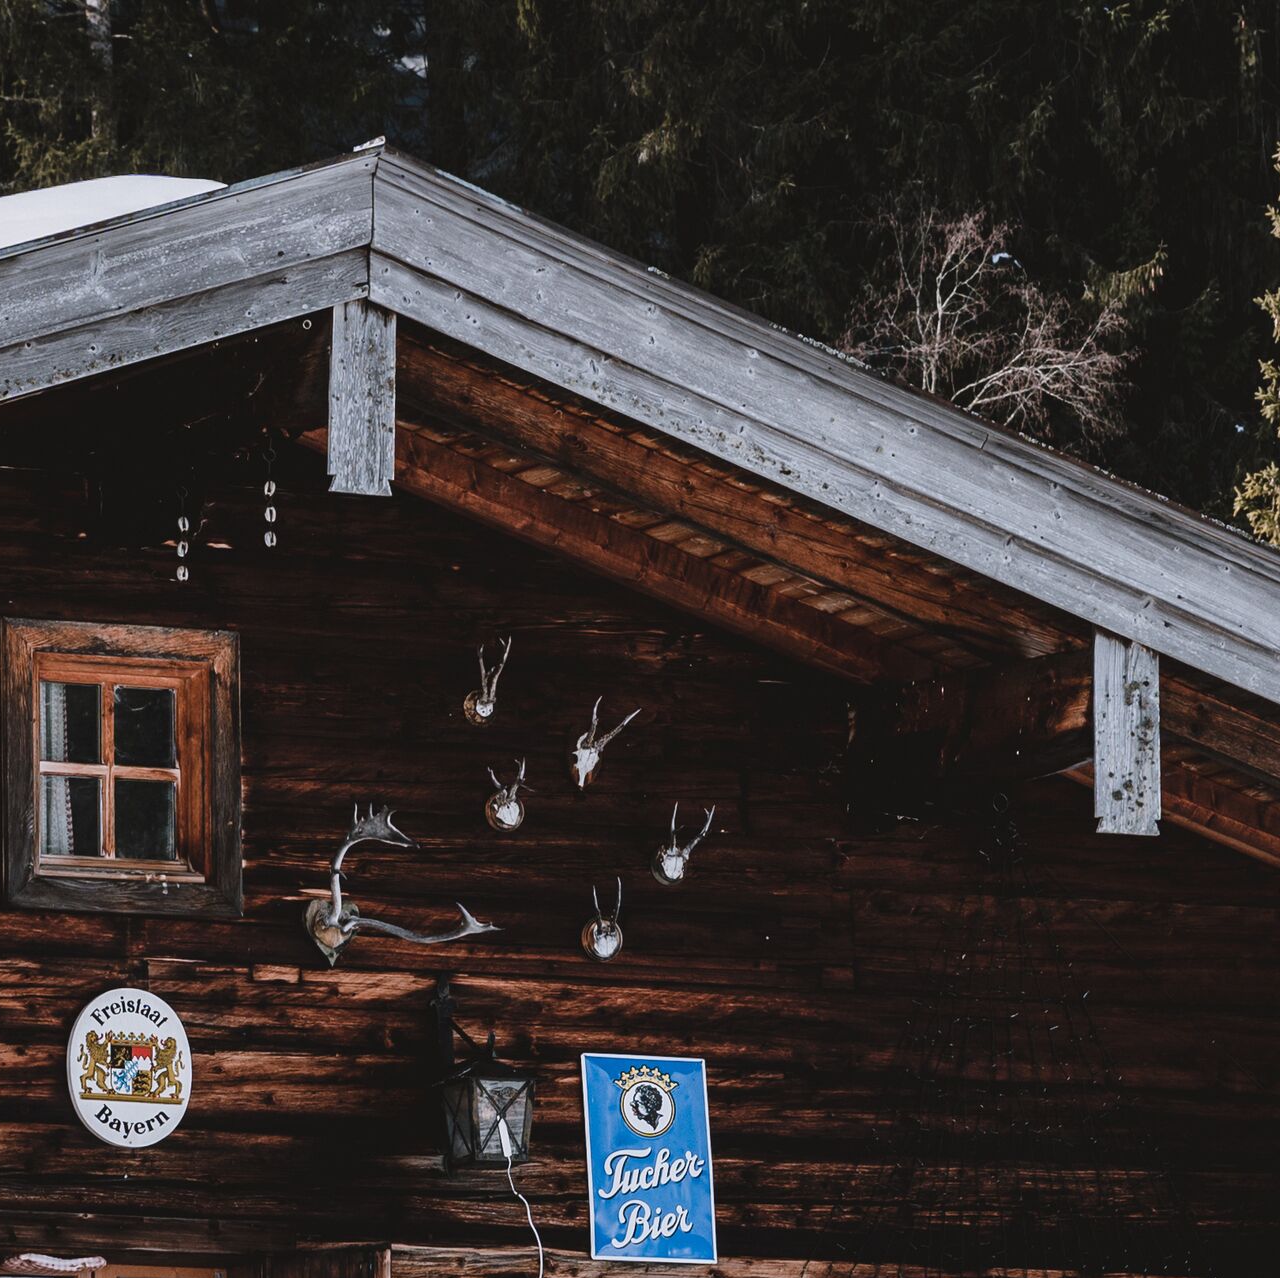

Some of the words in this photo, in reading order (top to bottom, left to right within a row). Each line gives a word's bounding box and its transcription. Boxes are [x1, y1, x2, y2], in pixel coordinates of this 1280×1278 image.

[90, 996, 169, 1028] Freistaat
[94, 1104, 171, 1139] Bayern
[611, 1199, 693, 1249] Bier
